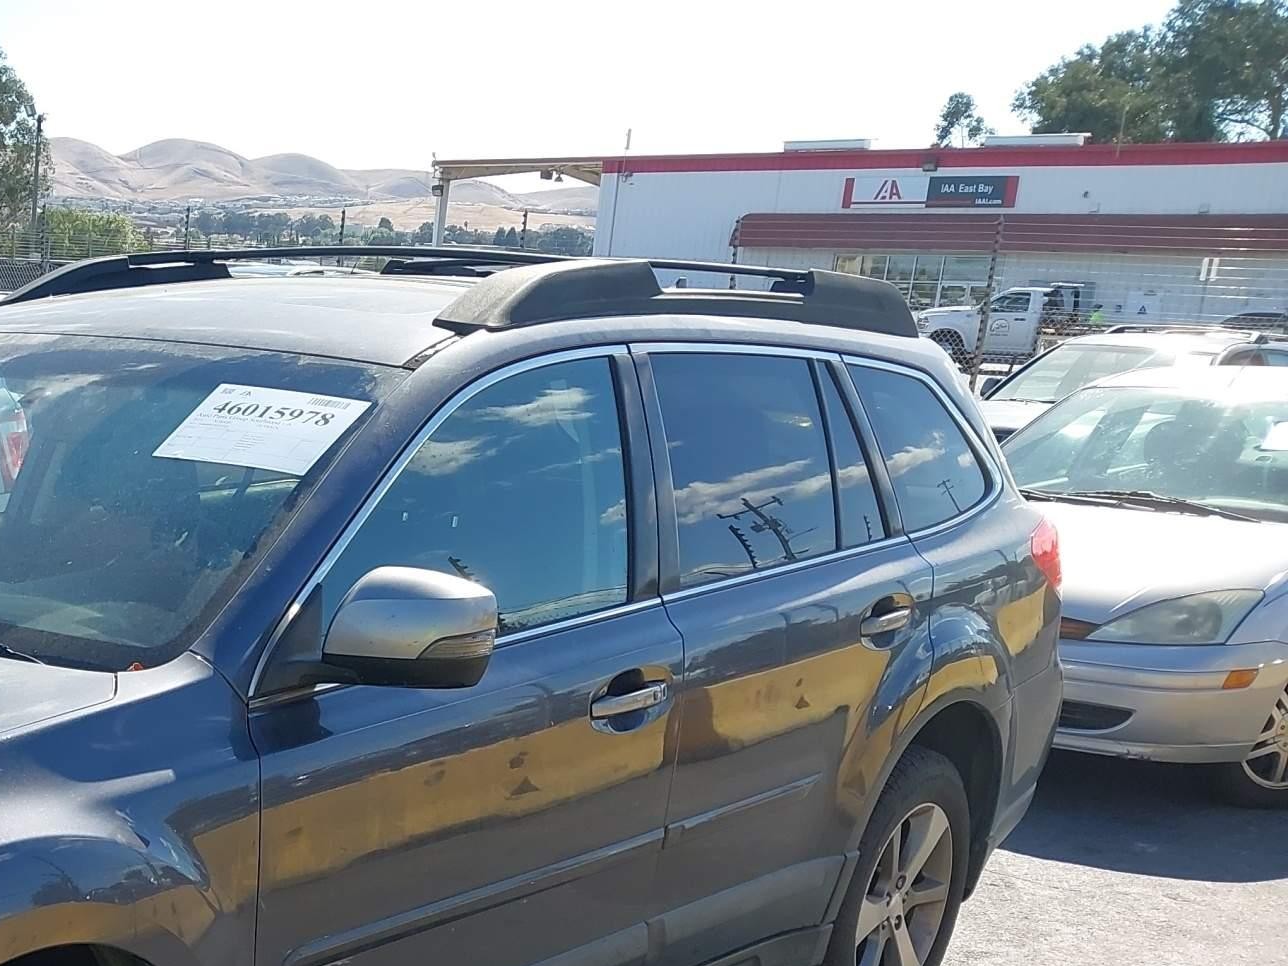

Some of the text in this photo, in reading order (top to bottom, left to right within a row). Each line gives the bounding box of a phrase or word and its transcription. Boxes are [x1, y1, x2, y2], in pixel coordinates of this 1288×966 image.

[941, 183, 994, 195] IAA East Bay
[213, 400, 335, 426] 46015978
